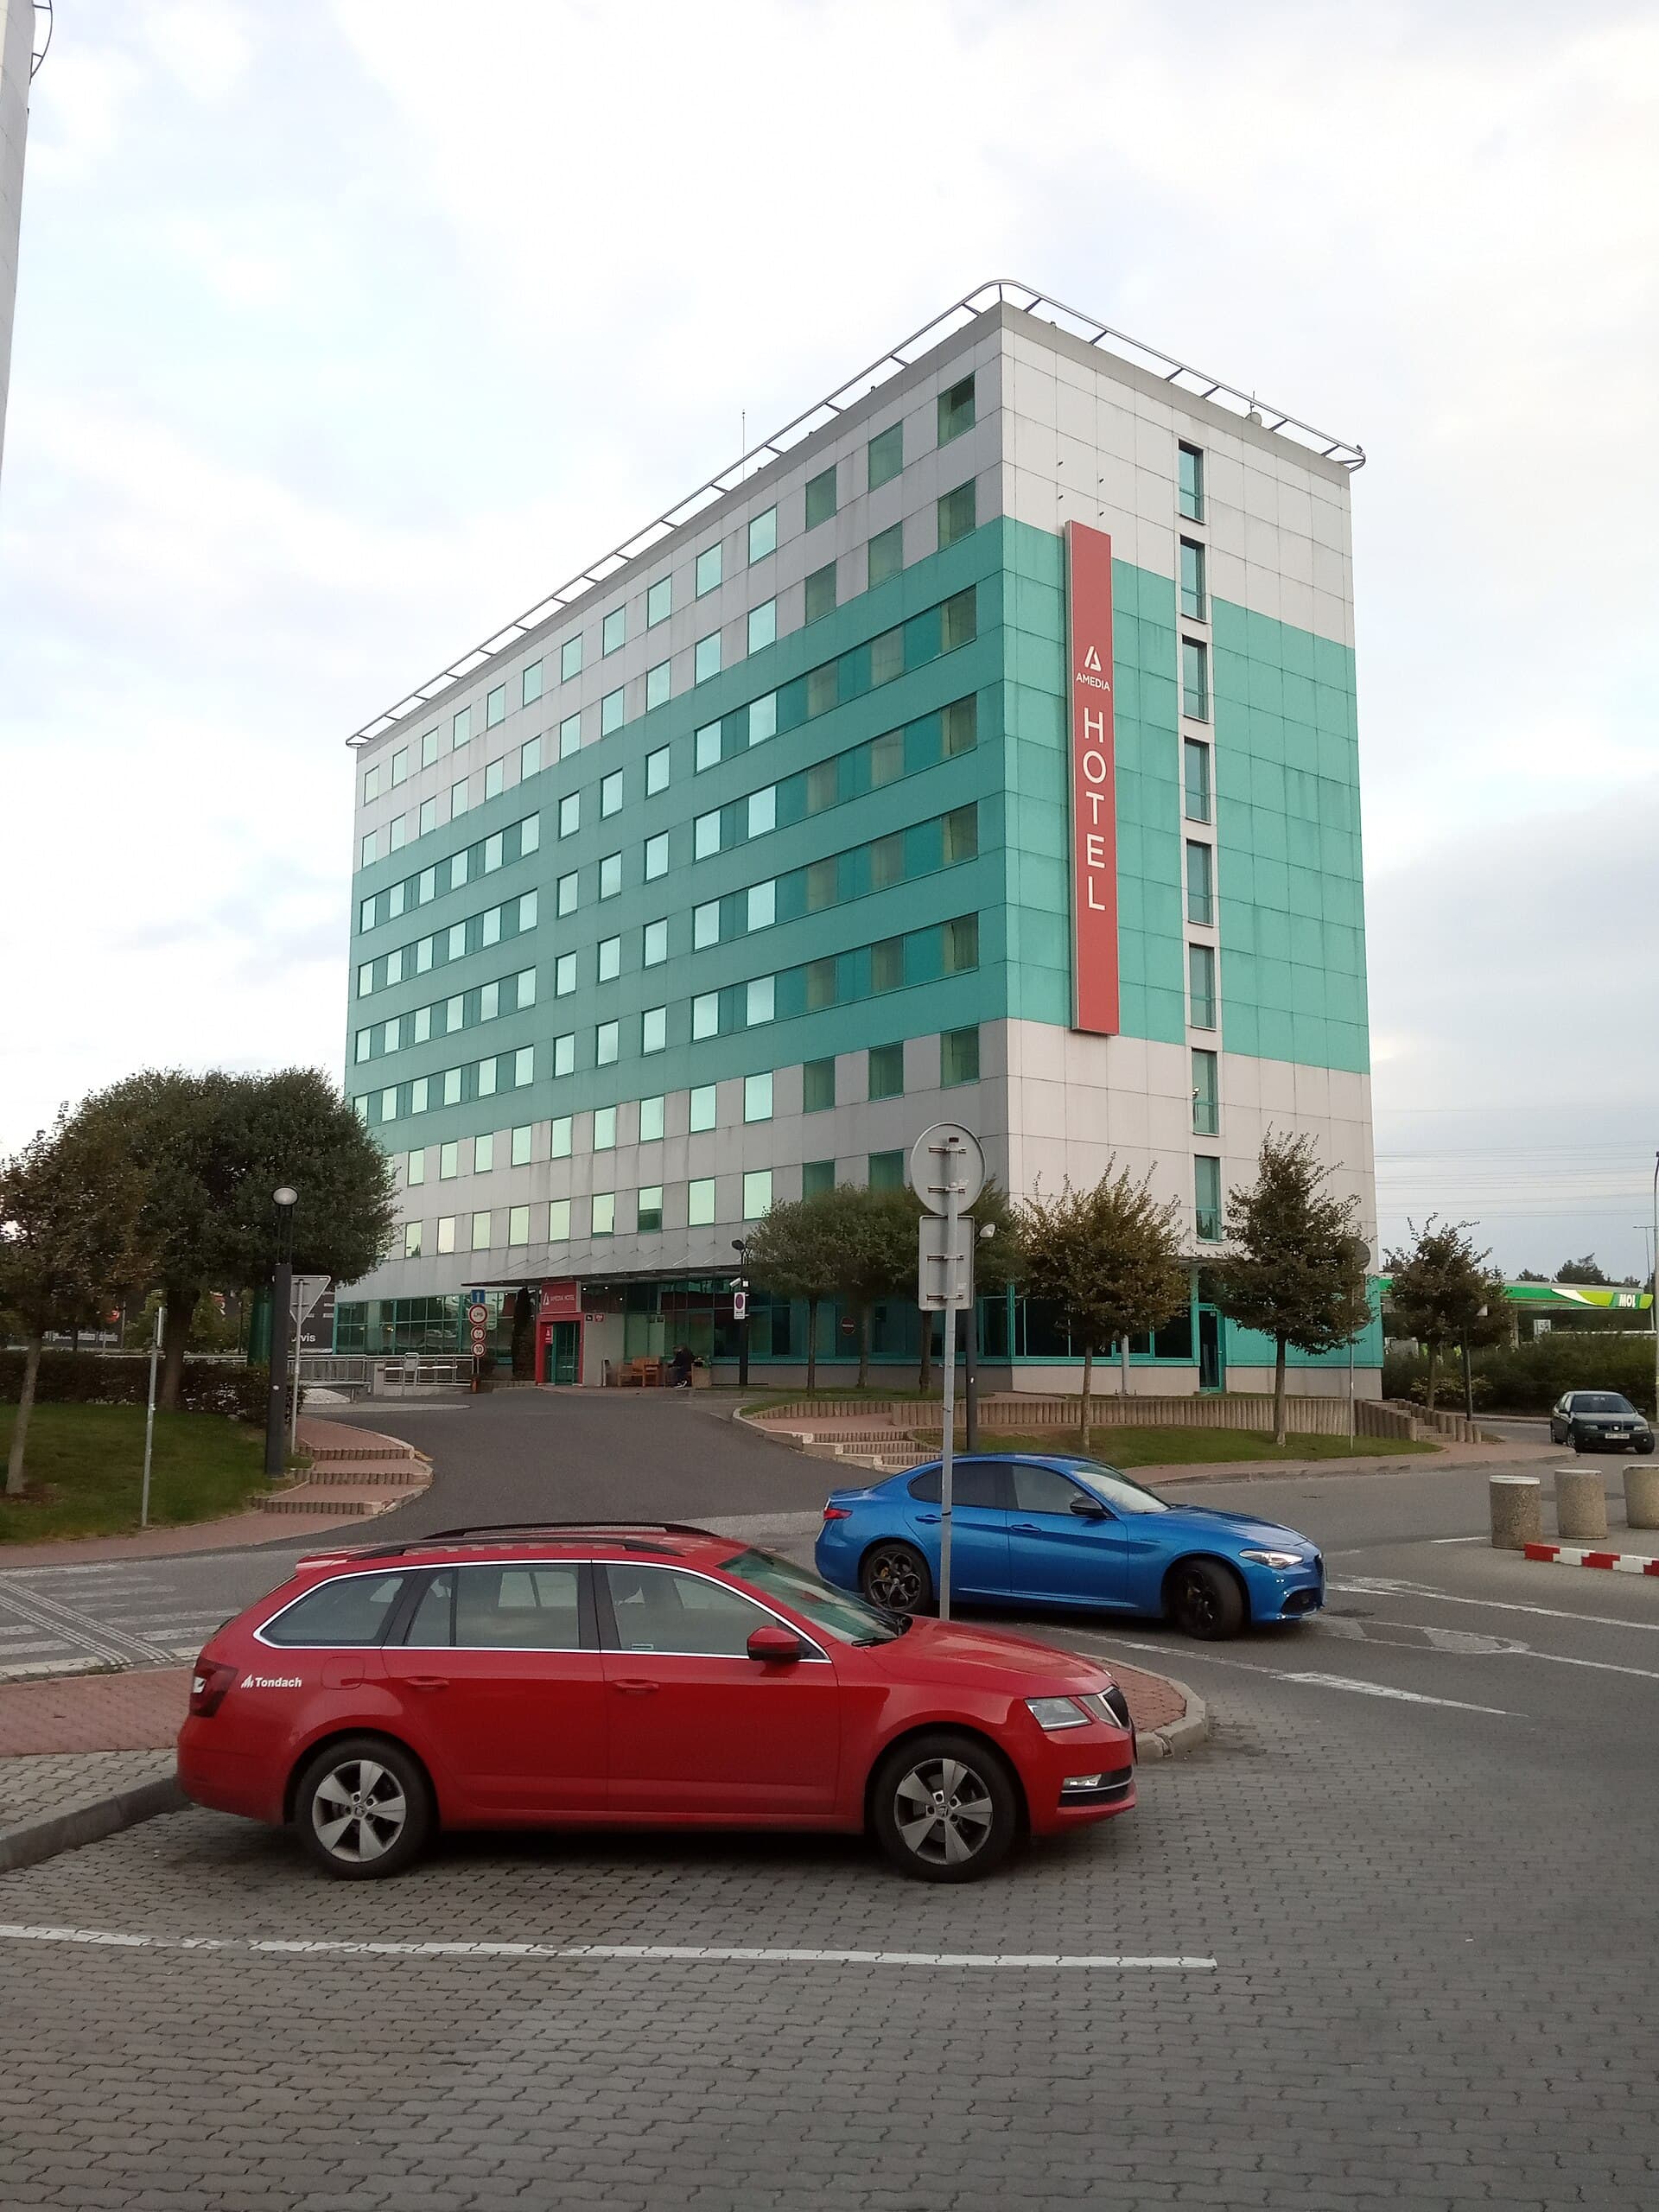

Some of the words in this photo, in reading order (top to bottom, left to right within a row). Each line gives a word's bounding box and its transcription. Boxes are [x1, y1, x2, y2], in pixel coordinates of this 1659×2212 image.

[1076, 672, 1111, 692] AMEDIA
[1082, 706, 1107, 911] HOTEL
[1618, 1294, 1636, 1307] MOL
[254, 1676, 302, 1688] Tondach
